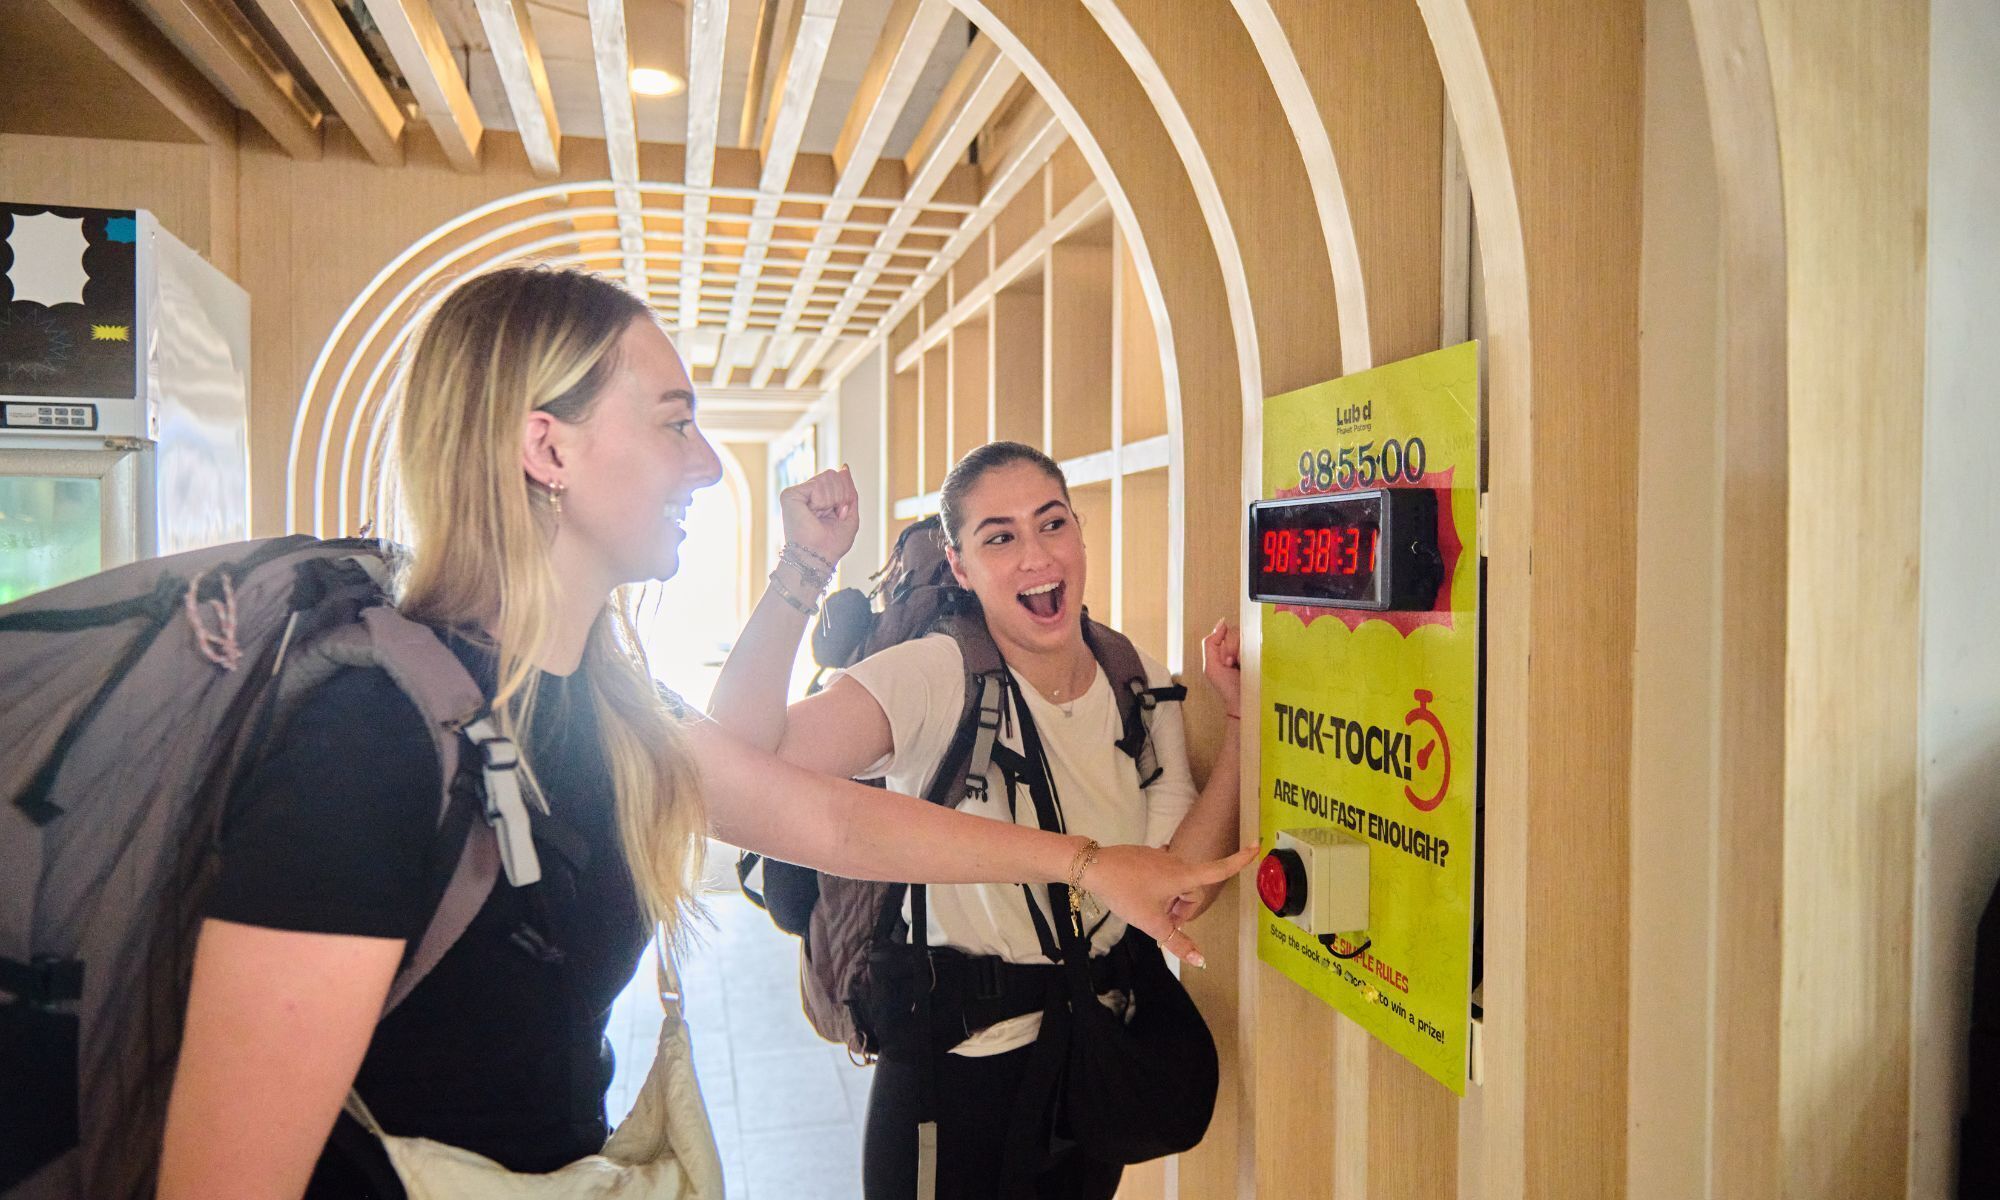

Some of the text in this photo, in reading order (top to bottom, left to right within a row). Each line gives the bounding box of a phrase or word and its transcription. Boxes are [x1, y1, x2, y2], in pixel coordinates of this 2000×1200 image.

[1336, 400, 1372, 426] Lub d
[1263, 528, 1378, 574] 98:38:31
[1274, 703, 1412, 781] TICK-TOCK!
[1273, 778, 1449, 867] ARE YOU FAST ENOUGH?
[1270, 923, 1287, 944] Stop
[1288, 934, 1300, 952] the
[1301, 944, 1320, 964] clock
[1378, 991, 1389, 1007] to
[1391, 1002, 1407, 1020] win
[1409, 1013, 1415, 1025] a
[1417, 1019, 1446, 1044] prize!
[1375, 958, 1409, 994] RULES
